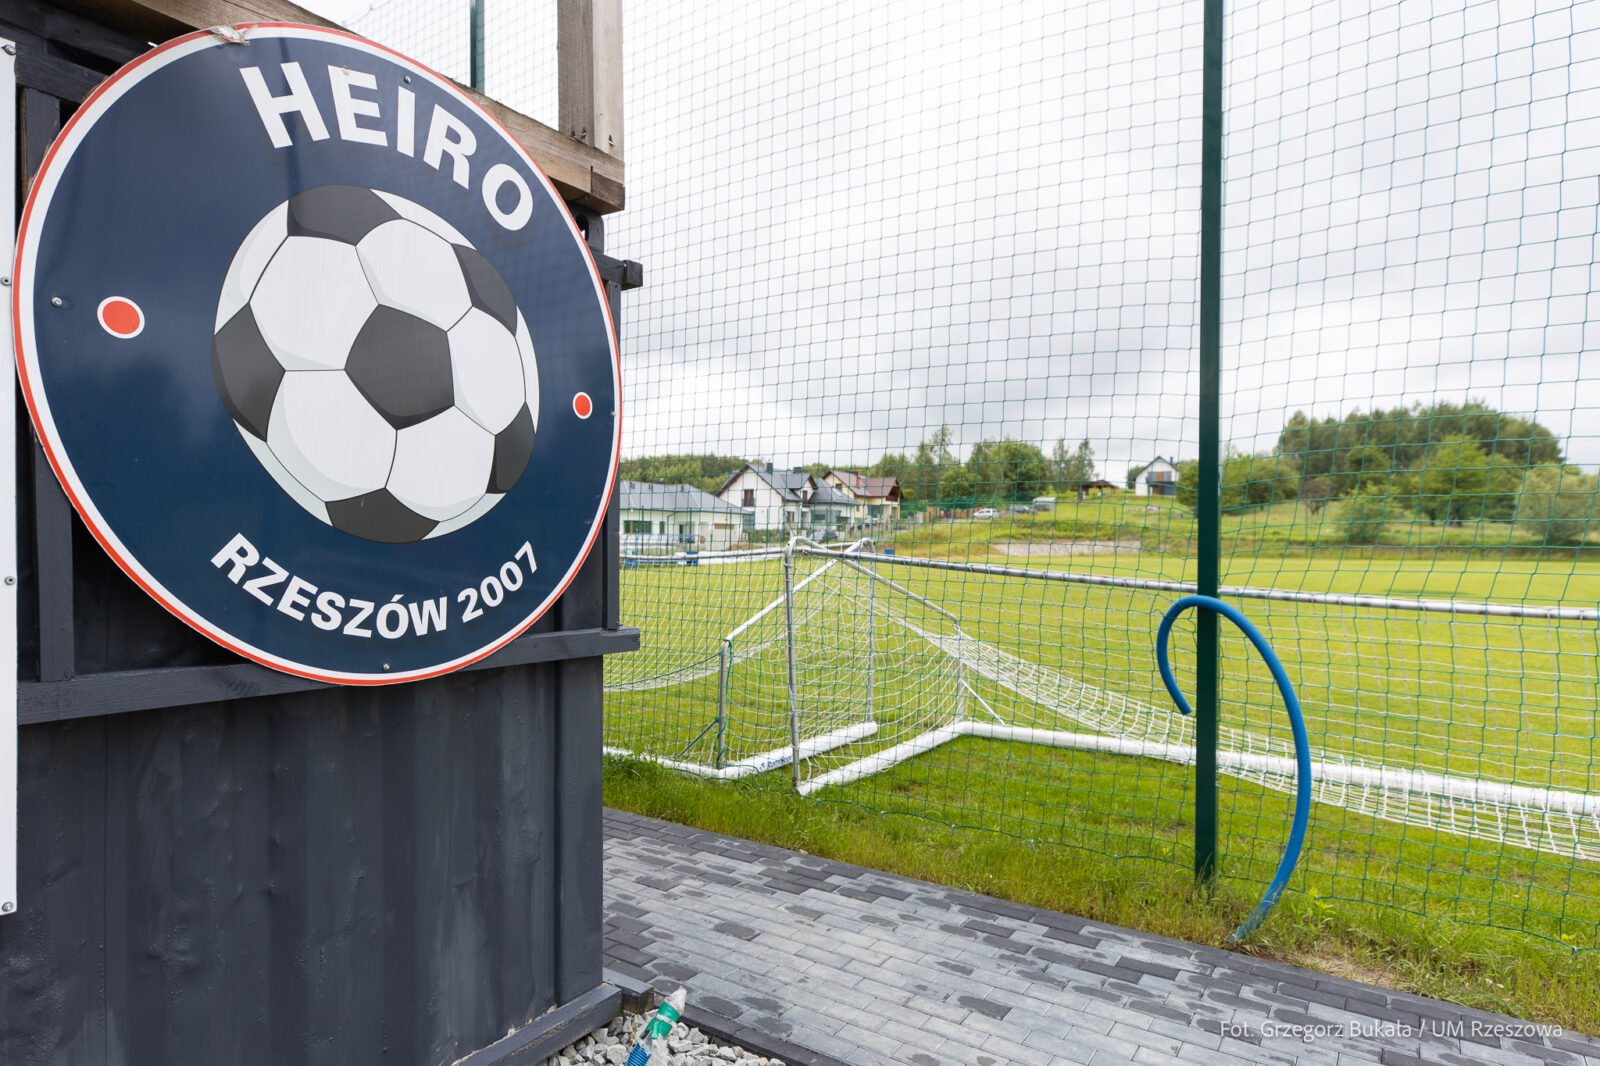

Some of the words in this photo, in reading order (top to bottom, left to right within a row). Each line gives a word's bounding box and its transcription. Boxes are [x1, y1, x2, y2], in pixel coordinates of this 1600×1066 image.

[239, 61, 533, 231] HEIRO
[210, 532, 448, 640] RZESZÓW
[457, 540, 538, 623] 2007
